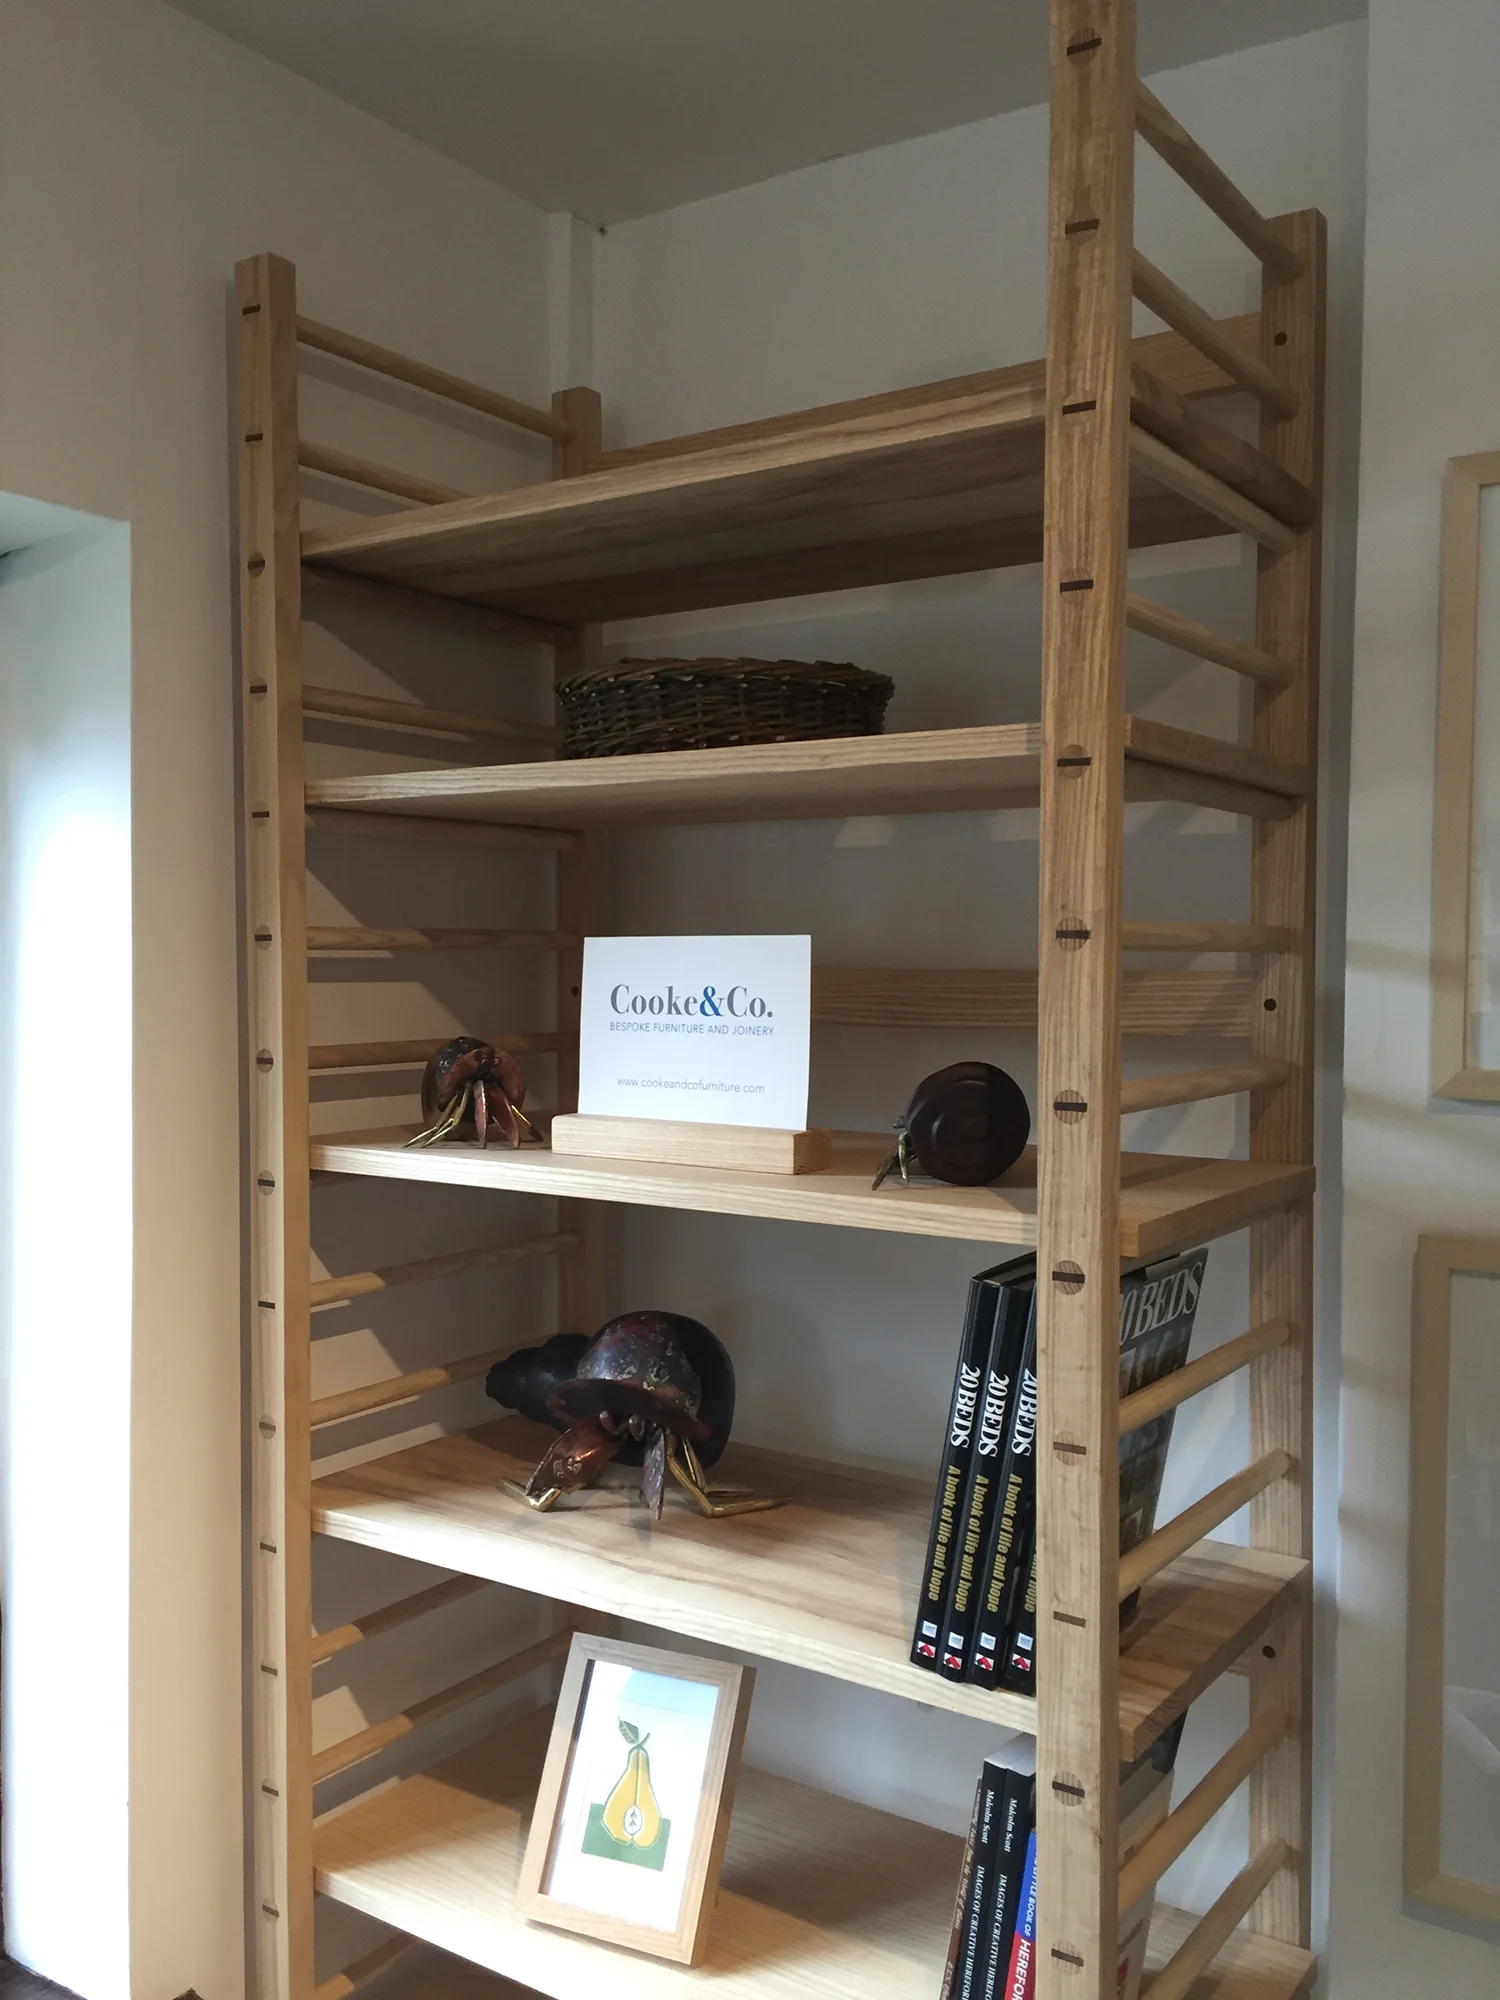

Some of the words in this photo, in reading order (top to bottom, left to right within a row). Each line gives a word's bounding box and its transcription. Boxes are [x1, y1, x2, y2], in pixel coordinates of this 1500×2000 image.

[610, 983, 773, 1018] Cooke&Co.
[609, 1021, 650, 1032] BESPOKE
[653, 1022, 704, 1034] FURNITURE
[707, 1024, 729, 1035] AND
[731, 1025, 775, 1036] JOINERY
[616, 1076, 765, 1094] www.cookeandcofurniture.com
[948, 1464, 961, 1475] A
[976, 1474, 989, 1485] A
[1009, 1472, 1023, 1484] A
[943, 1475, 960, 1507] book
[971, 1485, 988, 1517] book
[1004, 1483, 1021, 1517] book
[941, 1508, 953, 1522] of
[968, 1517, 981, 1532] of
[1001, 1517, 1014, 1533] of
[937, 1521, 952, 1543] life
[964, 1532, 980, 1554] life
[997, 1531, 1013, 1554] life
[933, 1544, 946, 1570] and
[960, 1554, 974, 1581] and
[993, 1554, 1007, 1581] and
[928, 1568, 945, 1601] hope
[954, 1579, 972, 1612] hope
[987, 1579, 1005, 1613] hope
[984, 1788, 995, 1823] Malcolm
[1006, 1797, 1018, 1832] Malcolm
[981, 1823, 991, 1844] Scott
[1004, 1831, 1013, 1853] Scott
[974, 1865, 985, 1900] IMAGES
[996, 1874, 1008, 1909] IMAGES
[972, 1900, 981, 1914] OF
[994, 1909, 1003, 1923] OF
[1025, 1897, 1036, 1924] BOOK
[966, 1913, 980, 1958] CREATIVE
[1024, 1924, 1032, 1937] OF
[989, 1922, 1002, 1967] CREATIVE
